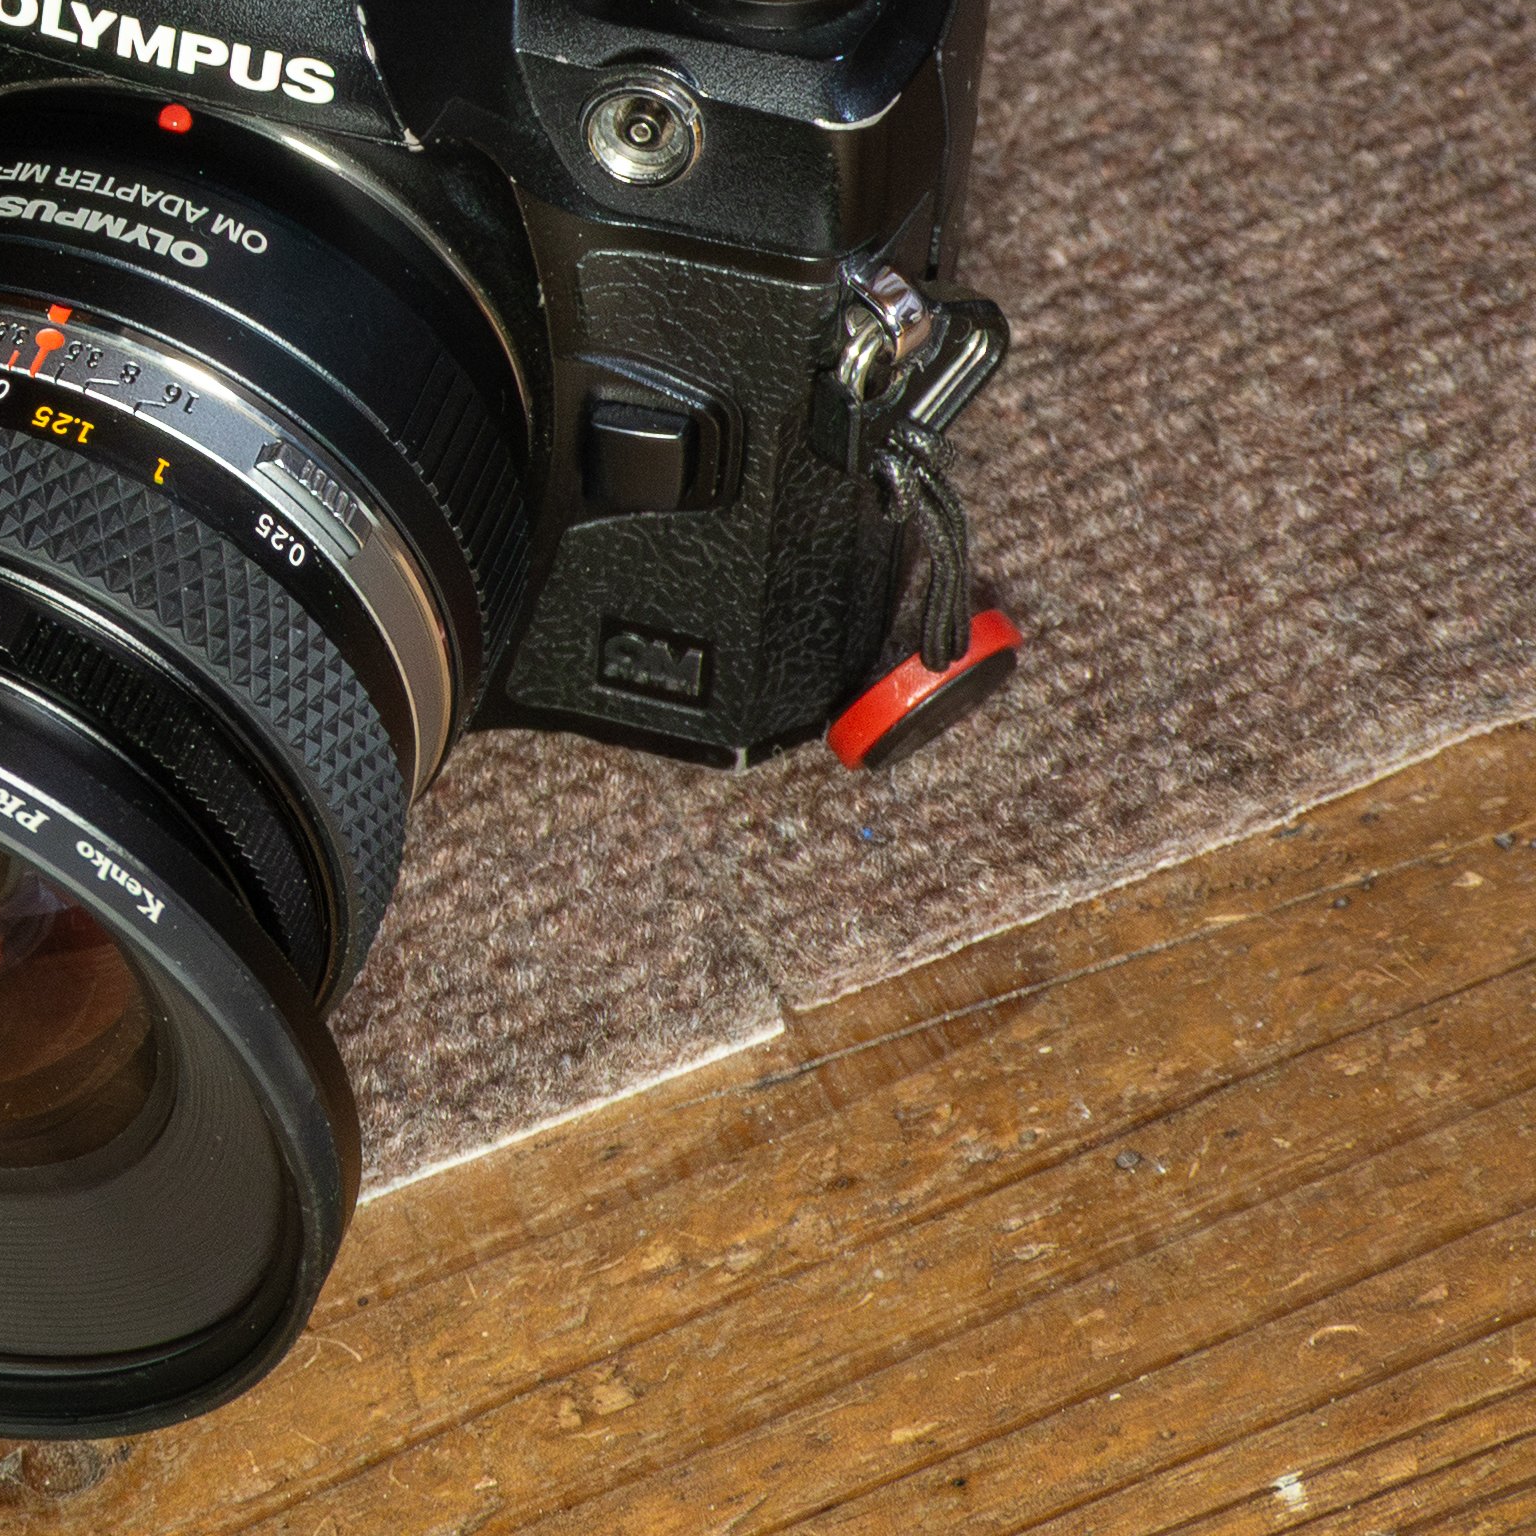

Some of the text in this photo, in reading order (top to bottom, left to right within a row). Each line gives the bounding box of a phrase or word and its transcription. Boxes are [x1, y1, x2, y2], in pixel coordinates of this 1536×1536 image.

[58, 167, 210, 224] ADAPTER
[212, 212, 269, 256] OM
[32, 406, 95, 445] 1.25
[253, 511, 308, 569] 0.25
[75, 837, 169, 924] Kenko
